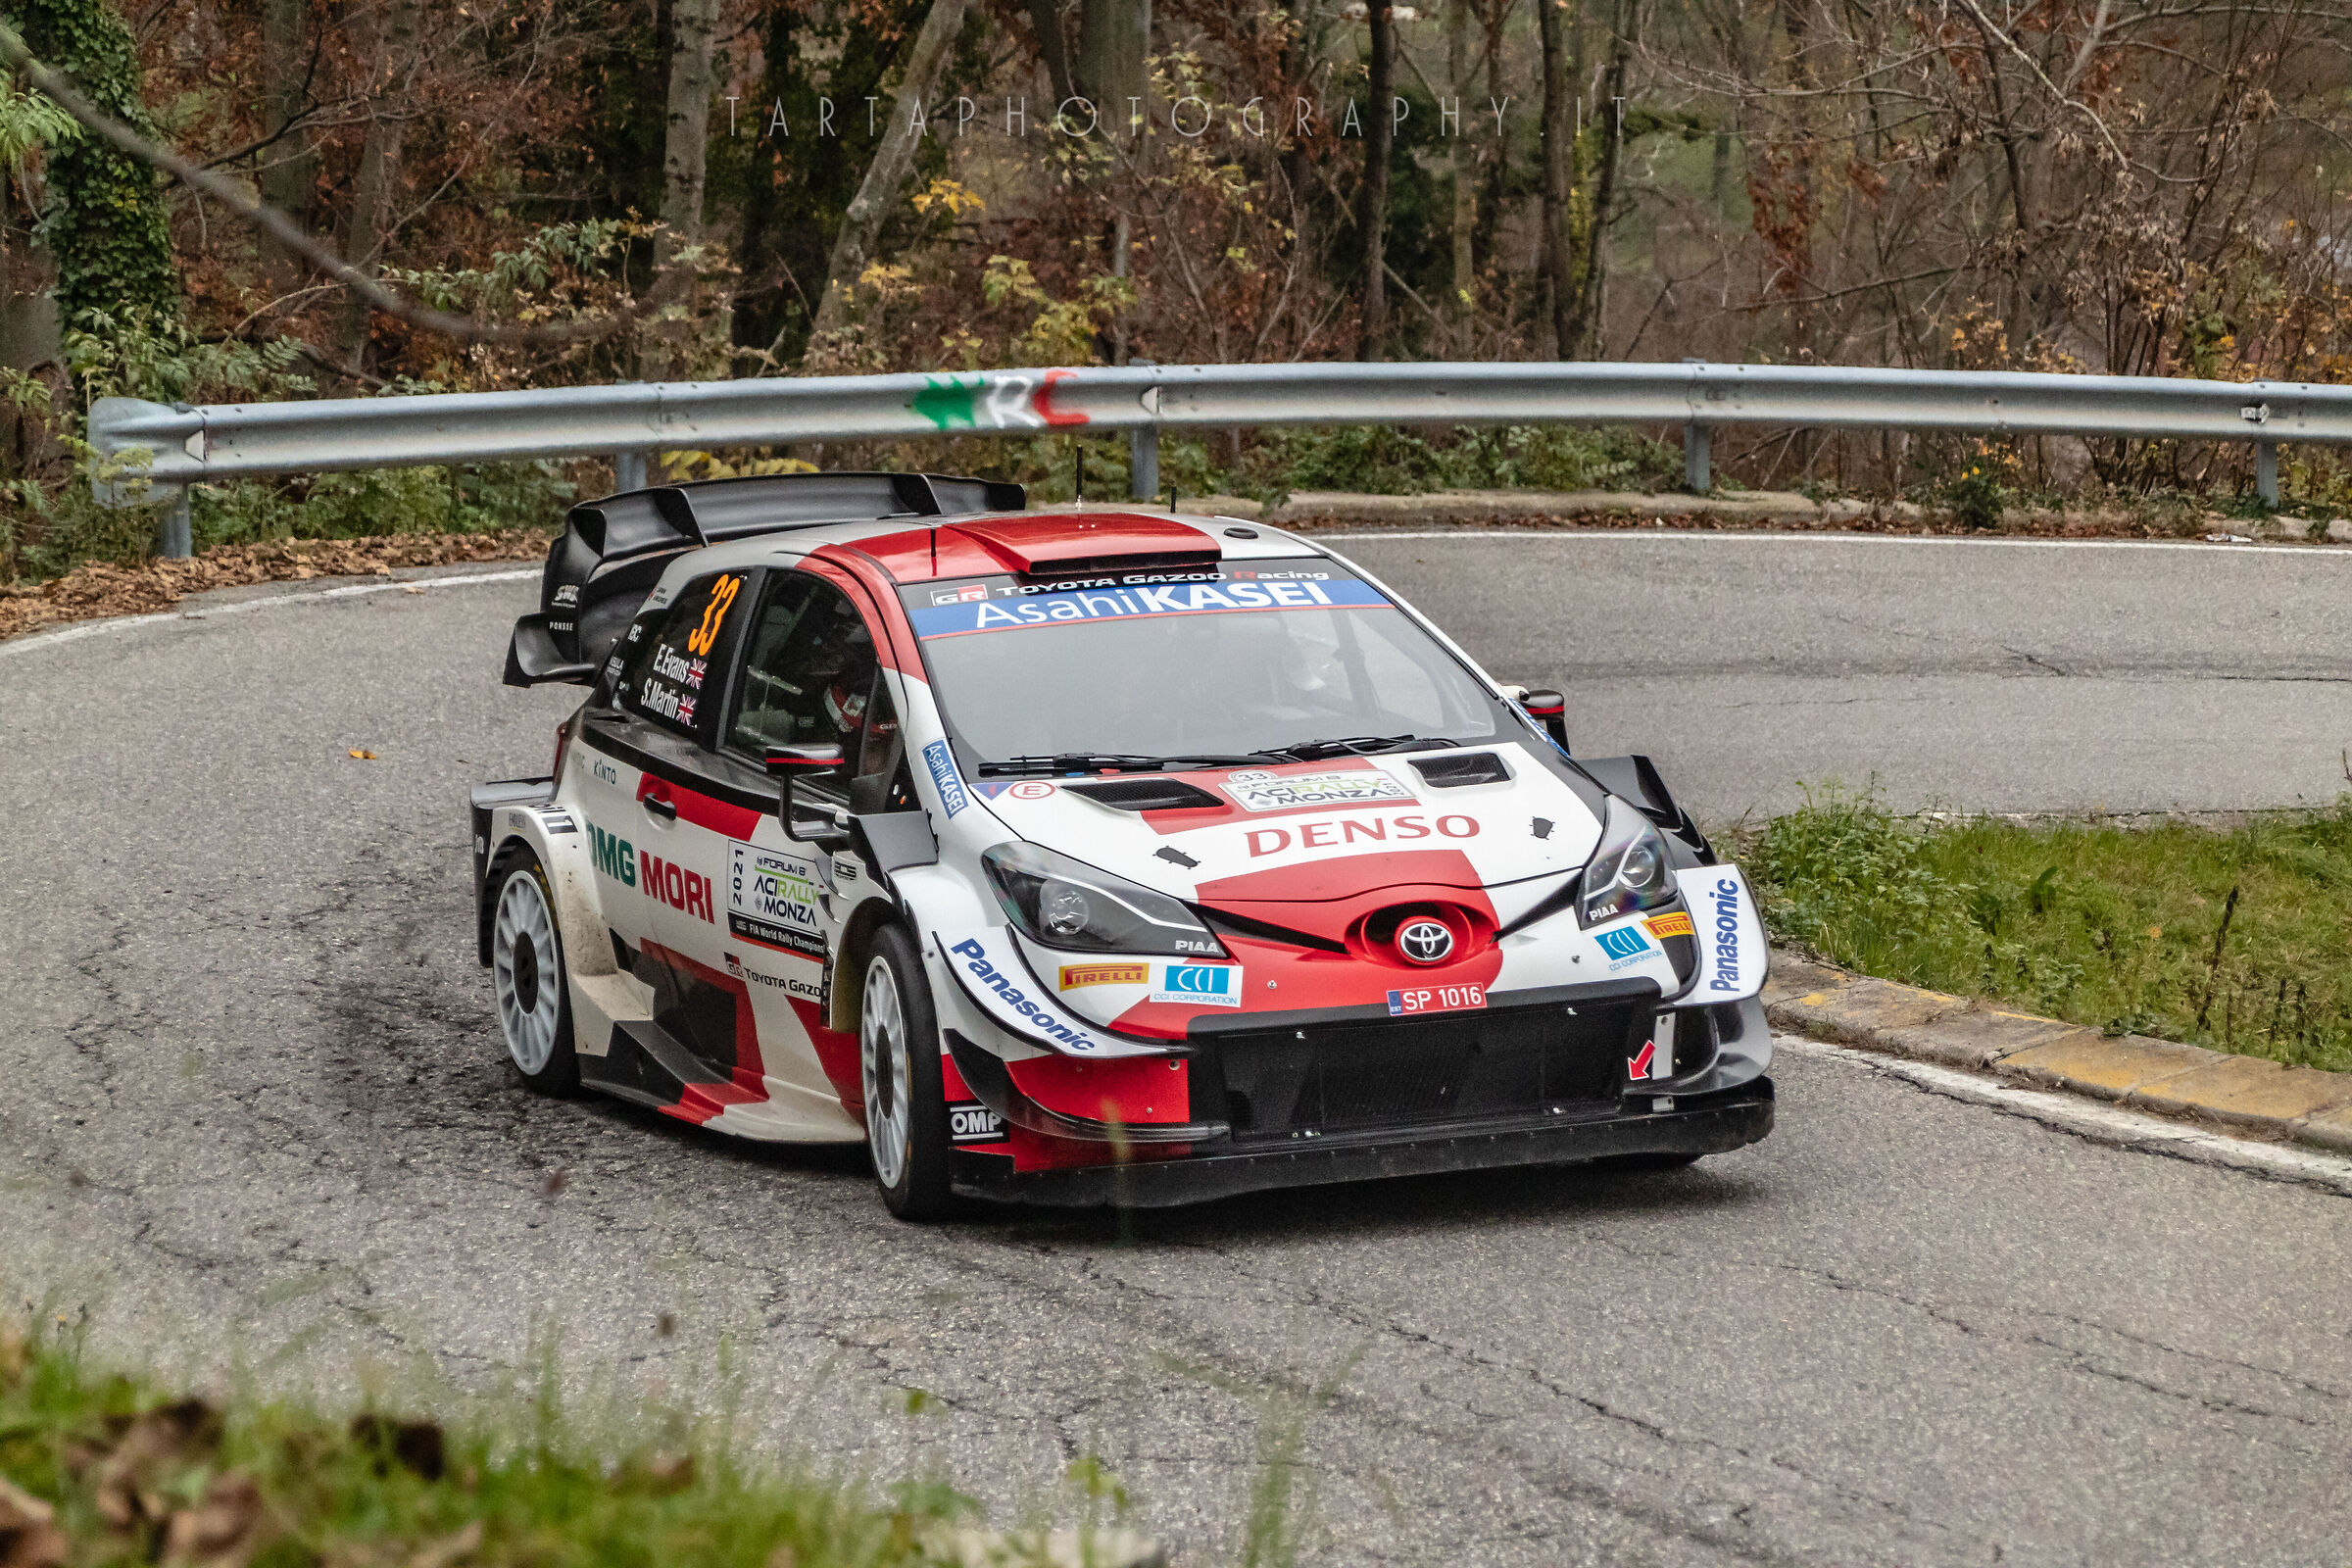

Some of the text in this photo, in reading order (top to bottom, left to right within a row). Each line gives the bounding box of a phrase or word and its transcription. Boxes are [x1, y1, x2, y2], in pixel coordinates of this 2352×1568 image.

[996, 577, 1116, 596] TOYOTA
[1122, 573, 1227, 585] GAZOO
[1233, 570, 1330, 581] Racing
[688, 573, 740, 656] 33
[976, 581, 1334, 628] AsahiKASEI
[653, 643, 690, 683] E.Evans
[641, 677, 679, 718] S.Martin
[1238, 772, 1267, 781] 33
[1022, 785, 1043, 796] E
[1277, 788, 1393, 805] MONZA
[1243, 813, 1482, 858] DENSO
[639, 850, 715, 925] MORI
[732, 849, 744, 906] 2021
[763, 896, 817, 927] MONZA
[1589, 904, 1619, 921] PIAA
[749, 923, 760, 935] FIA
[760, 926, 777, 941] World
[777, 930, 793, 947] Rally
[1175, 940, 1220, 953] PIAA
[1709, 878, 1740, 993] Panasonic
[743, 966, 787, 990] TOYOTA
[1064, 965, 1144, 986] PIRELLI
[950, 938, 1096, 1052] Panasonic
[1172, 994, 1238, 1004] CORPORATION
[1402, 986, 1482, 1010] SP 1016
[950, 1111, 1003, 1134] OMP
